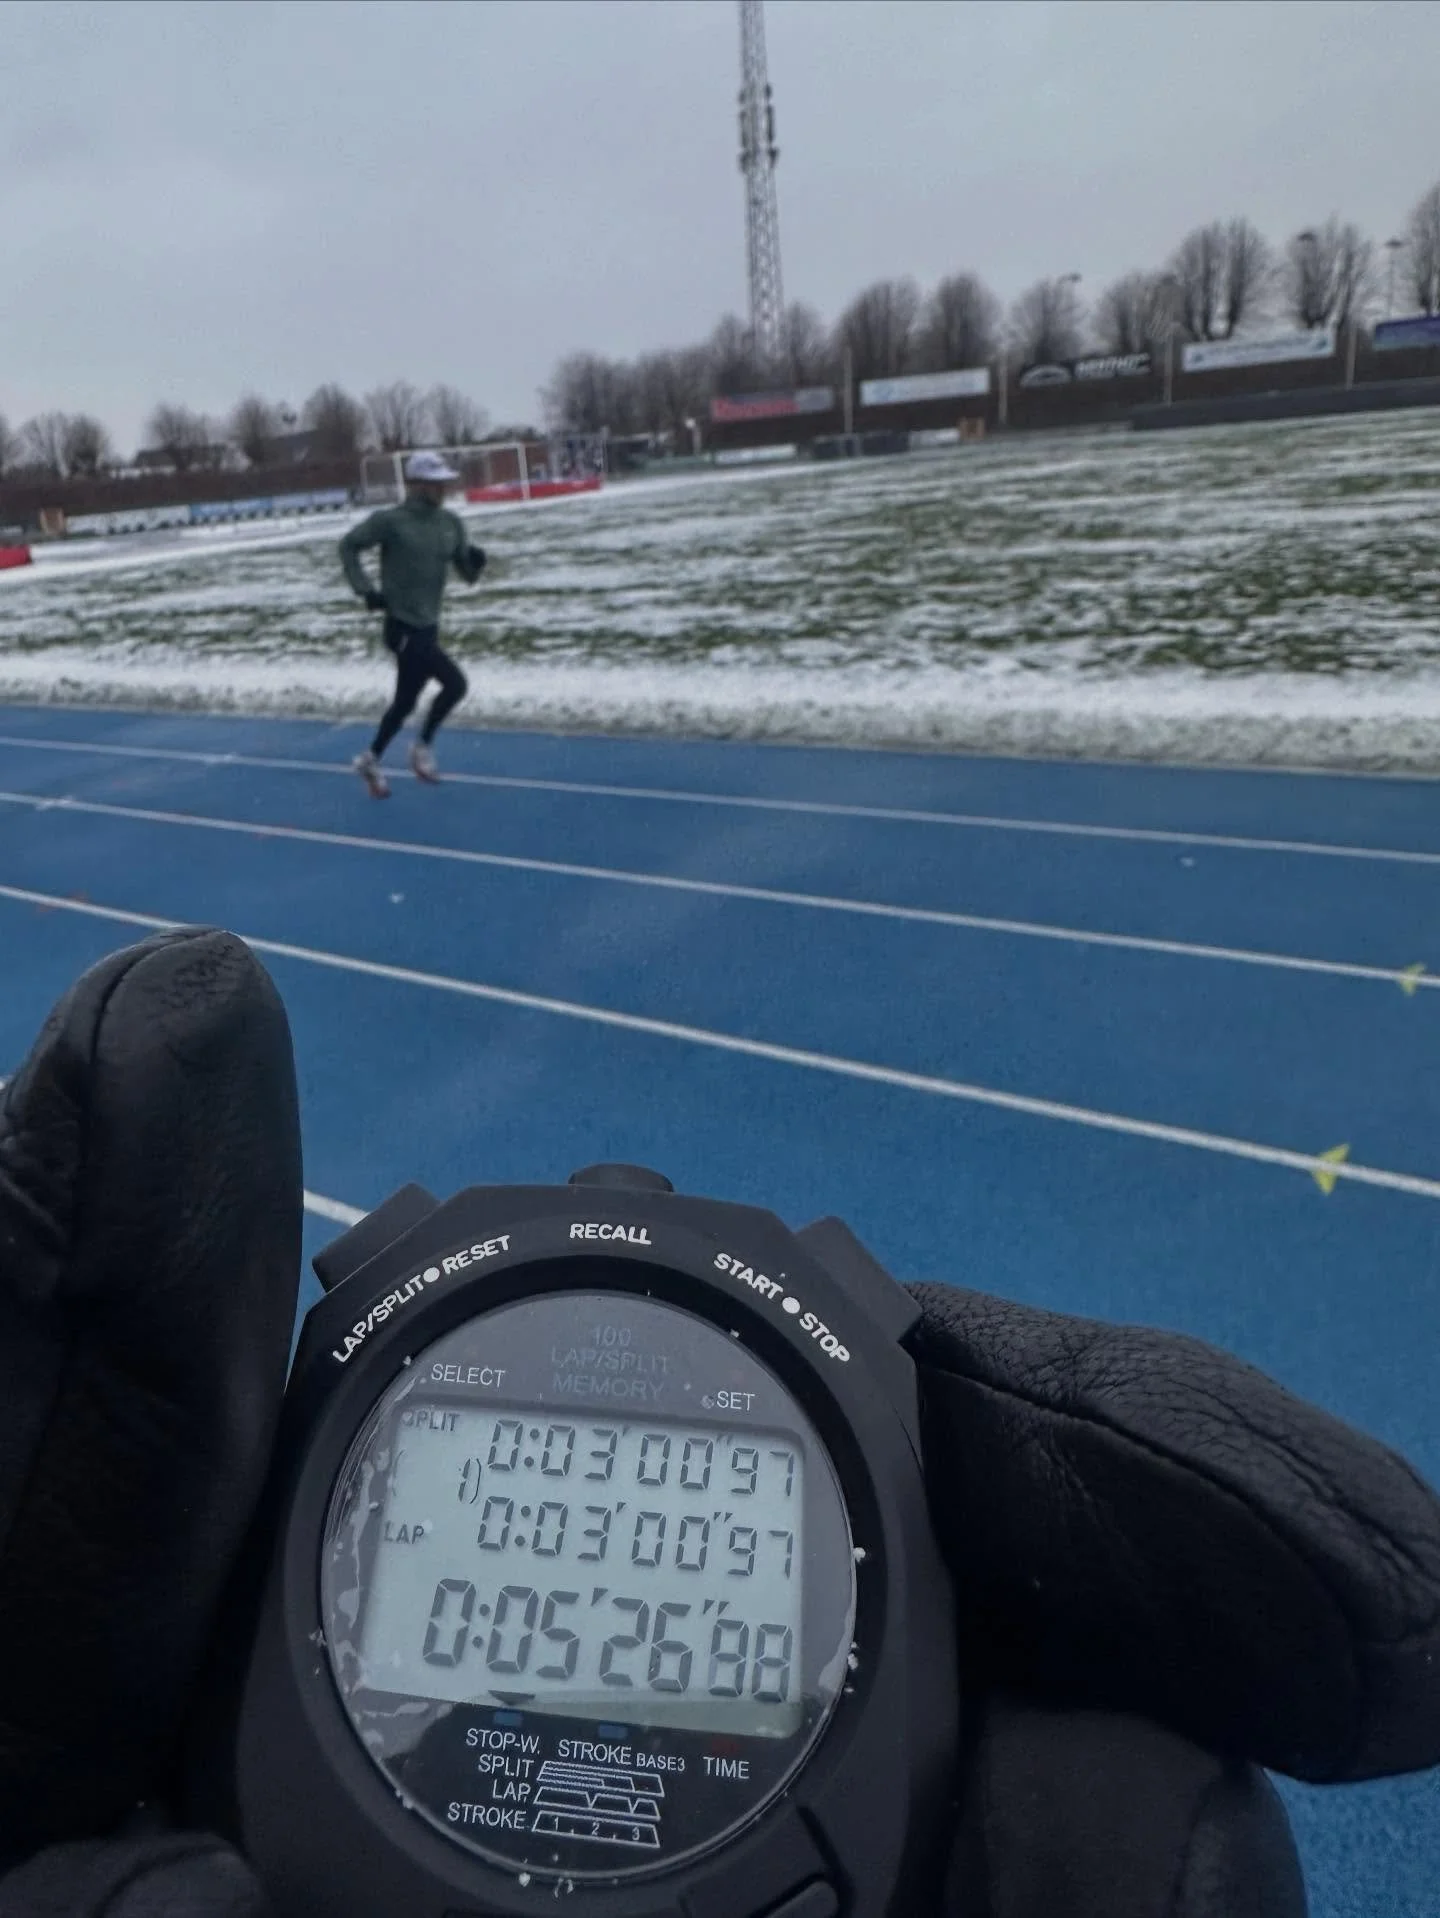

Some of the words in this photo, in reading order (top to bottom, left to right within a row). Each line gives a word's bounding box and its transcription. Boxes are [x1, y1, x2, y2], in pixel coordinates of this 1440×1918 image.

[569, 1223, 652, 1246] RECALL
[443, 1235, 513, 1277] RESET
[713, 1252, 784, 1300] START
[799, 1312, 851, 1365] STOP
[430, 1363, 506, 1389] SELECT
[553, 1373, 665, 1400] MEMORY
[716, 1391, 756, 1412] SET
[401, 1409, 460, 1432] SPLIT
[384, 1519, 425, 1545] LAP
[478, 1753, 535, 1778] SPLIT
[558, 1738, 632, 1766] STROKE
[635, 1752, 686, 1773] BASE3
[703, 1755, 751, 1781] TIME
[447, 1801, 528, 1830] STROKE
[591, 1821, 601, 1837] 2
[631, 1826, 641, 1841] 3
